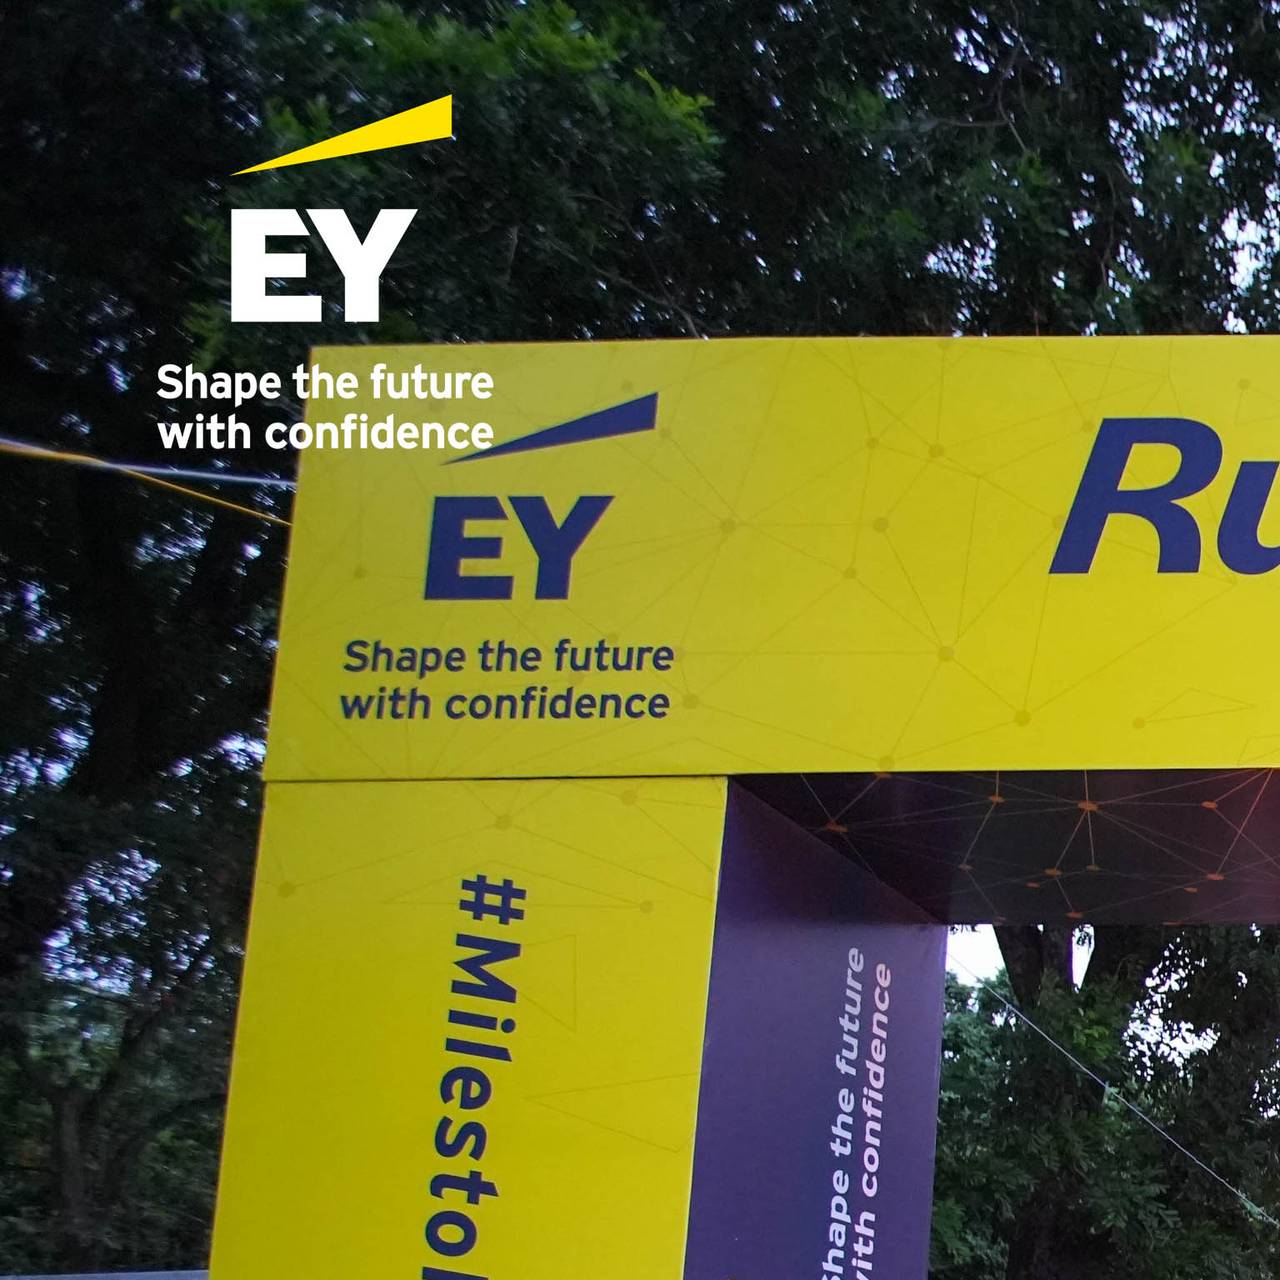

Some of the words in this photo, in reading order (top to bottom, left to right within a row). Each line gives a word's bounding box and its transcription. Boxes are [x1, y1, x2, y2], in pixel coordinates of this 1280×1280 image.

[423, 495, 615, 600] EY
[340, 687, 432, 719] with
[446, 687, 671, 720] confidence
[343, 640, 467, 679] Shape
[478, 641, 546, 671] the
[555, 640, 674, 672] future
[836, 947, 865, 1076] future
[831, 1084, 855, 1156] the
[861, 963, 893, 1198] confidence
